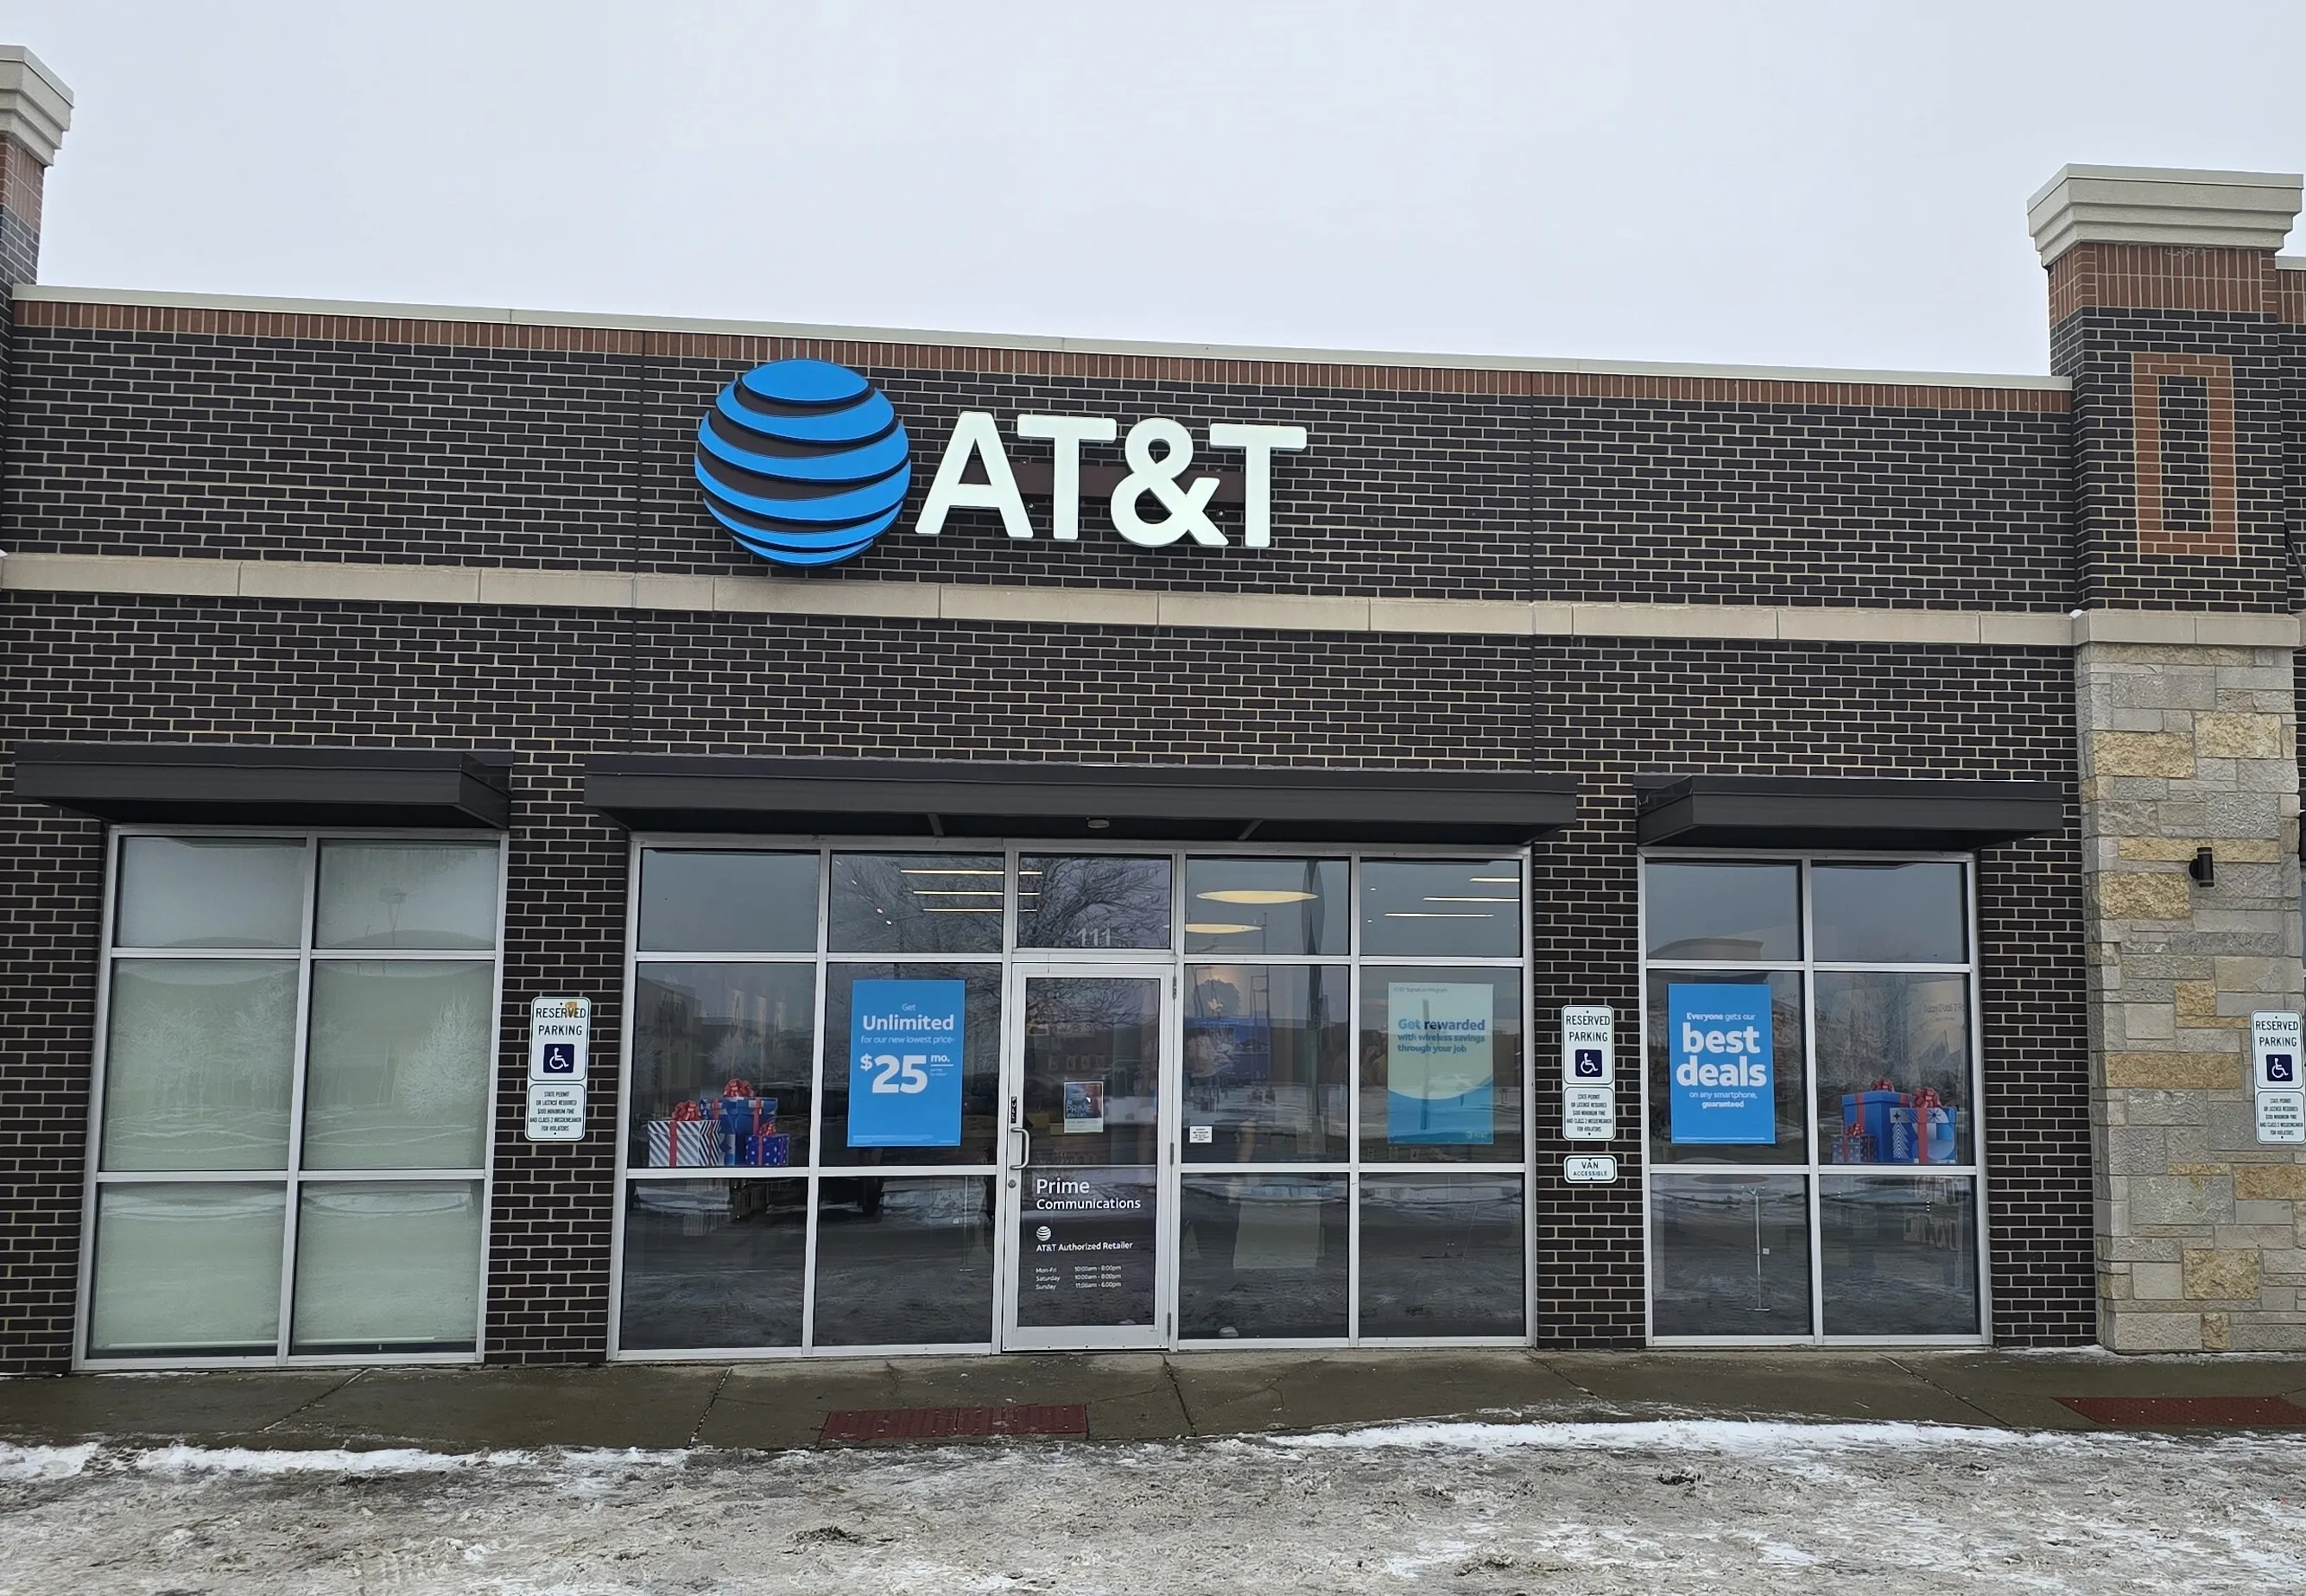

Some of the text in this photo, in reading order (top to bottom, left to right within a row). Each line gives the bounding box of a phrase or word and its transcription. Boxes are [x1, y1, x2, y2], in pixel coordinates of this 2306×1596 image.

[915, 411, 1307, 548] AT&T
[1076, 928, 1110, 947] 111
[535, 1008, 586, 1018] RESERVED
[1687, 1012, 1723, 1022] Everyone
[863, 1014, 954, 1030] Unlimited
[1398, 1019, 1485, 1030] Get rewarded
[1566, 1015, 1610, 1026] RESERVED
[2255, 1021, 2298, 1030] RESERVED
[538, 1025, 583, 1036] PARKING
[1397, 1033, 1485, 1043] with wireless savings
[1568, 1032, 1608, 1042] PARKING
[1682, 1022, 1760, 1054] best
[2259, 1037, 2297, 1047] PARKING
[1397, 1043, 1467, 1054] through your job
[860, 1053, 928, 1094] $25
[1676, 1055, 1767, 1086] deals
[1701, 1100, 1745, 1109] guaranteed
[1036, 1177, 1090, 1194] Prime
[1036, 1197, 1141, 1209] Communications
[1036, 1241, 1133, 1252] AT&T Authorized Retailer
